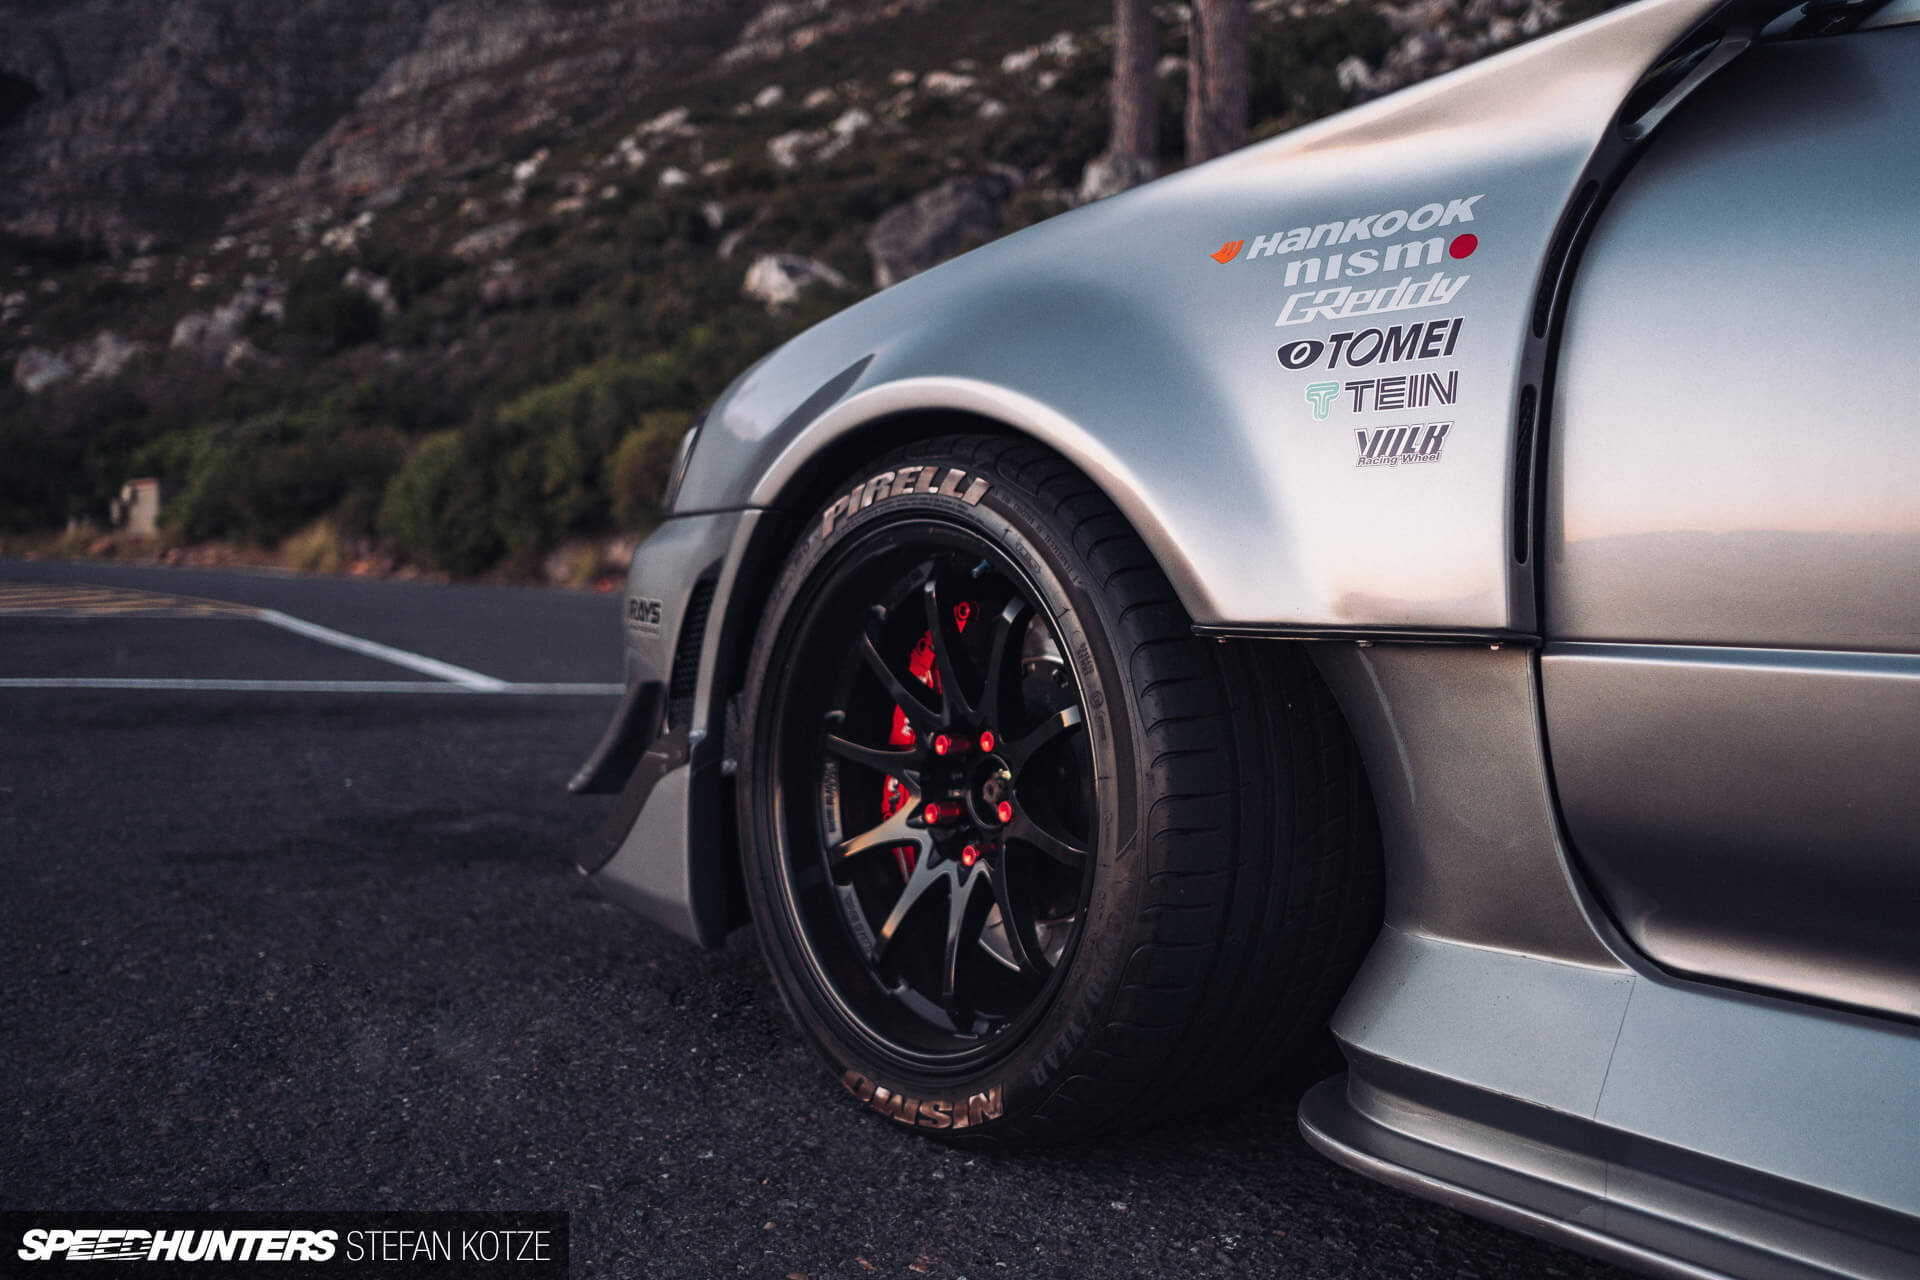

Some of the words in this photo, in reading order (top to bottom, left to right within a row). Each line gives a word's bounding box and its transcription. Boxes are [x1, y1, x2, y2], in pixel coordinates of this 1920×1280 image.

[1327, 316, 1465, 370] TOMEI
[1345, 370, 1459, 413] TEIN
[1358, 455, 1398, 466] Racing
[821, 465, 992, 540] PIRELLI
[630, 598, 662, 624] RAYS
[841, 1069, 1004, 1130] NISMO
